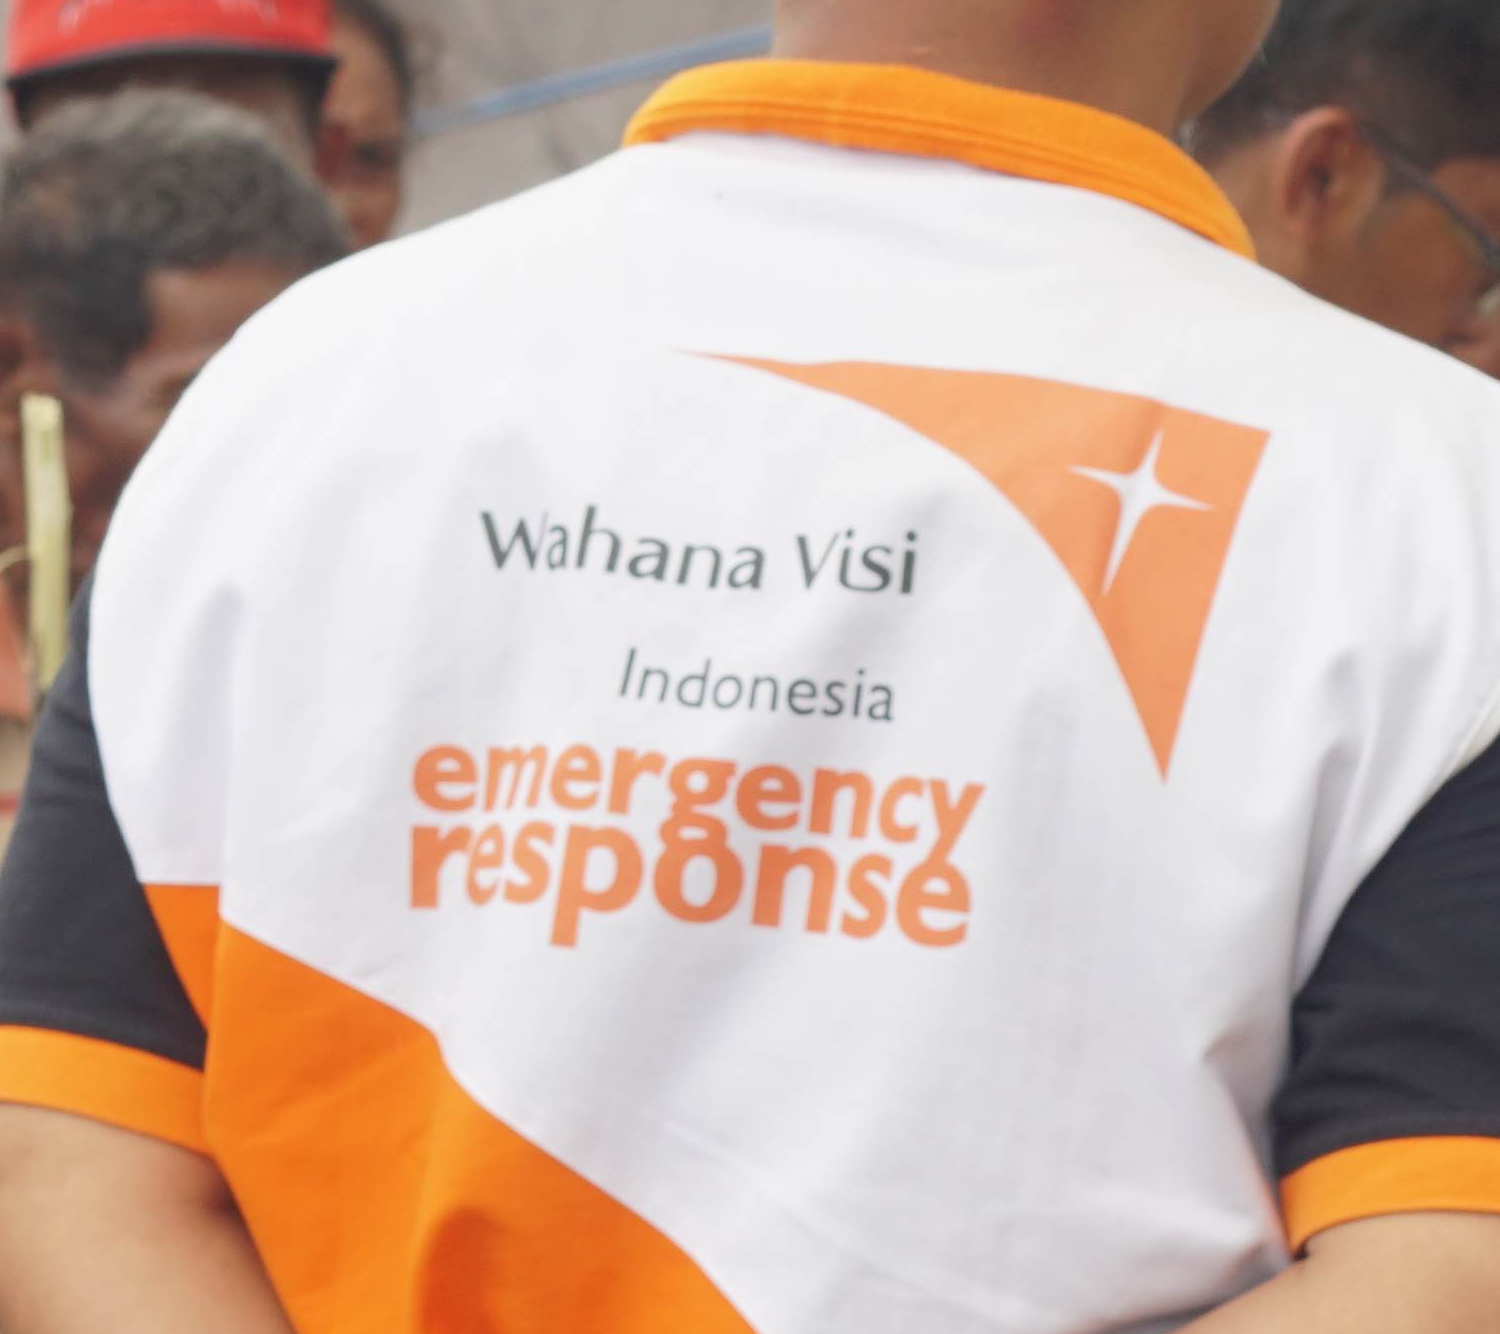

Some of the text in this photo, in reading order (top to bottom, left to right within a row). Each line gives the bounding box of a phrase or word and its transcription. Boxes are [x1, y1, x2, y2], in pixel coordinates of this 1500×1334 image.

[479, 504, 919, 596] Wahana Visi
[617, 647, 896, 723] Indonesia
[410, 741, 987, 864] emergency
[408, 814, 973, 949] response
